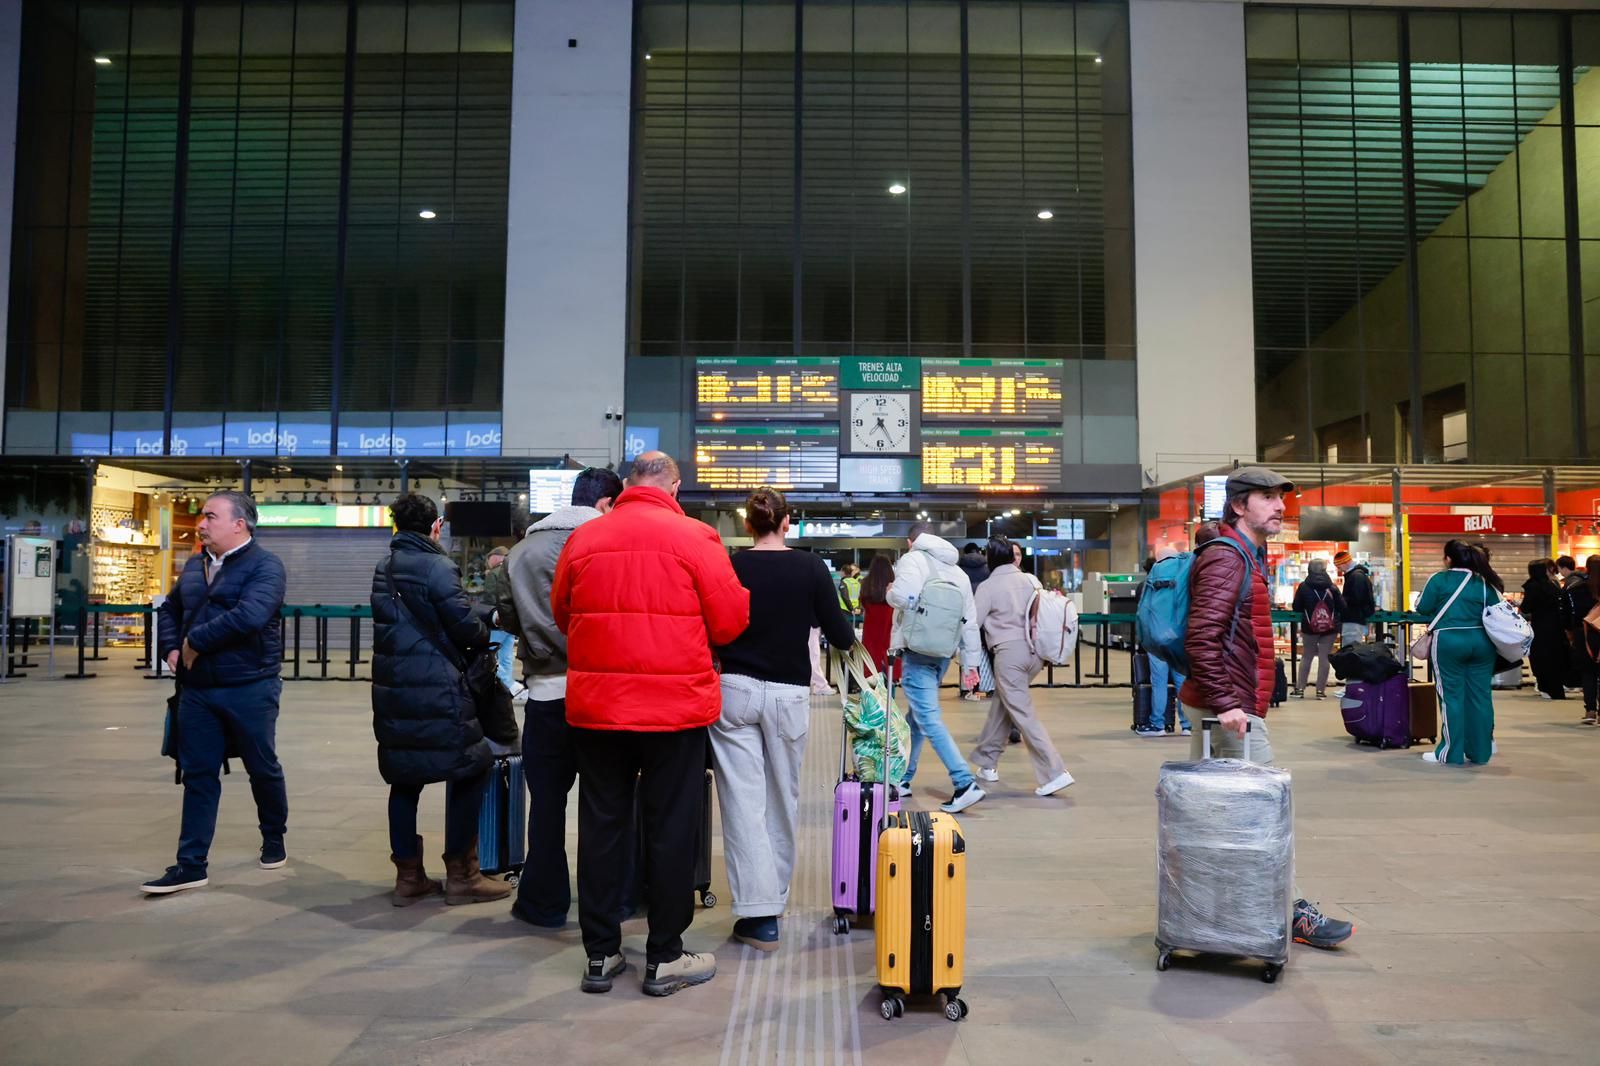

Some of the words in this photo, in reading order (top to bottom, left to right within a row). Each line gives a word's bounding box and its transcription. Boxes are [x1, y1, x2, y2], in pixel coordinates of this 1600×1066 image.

[858, 362, 884, 372] TRENES
[886, 362, 903, 372] ALTA
[862, 373, 899, 382] VELOCIDAD
[875, 398, 887, 406] 12
[855, 418, 863, 427] 9
[898, 419, 905, 427] 3
[876, 439, 885, 448] 6
[860, 464, 877, 474] HIGH
[880, 464, 902, 475] SPEED
[1464, 515, 1493, 531] RELAY
